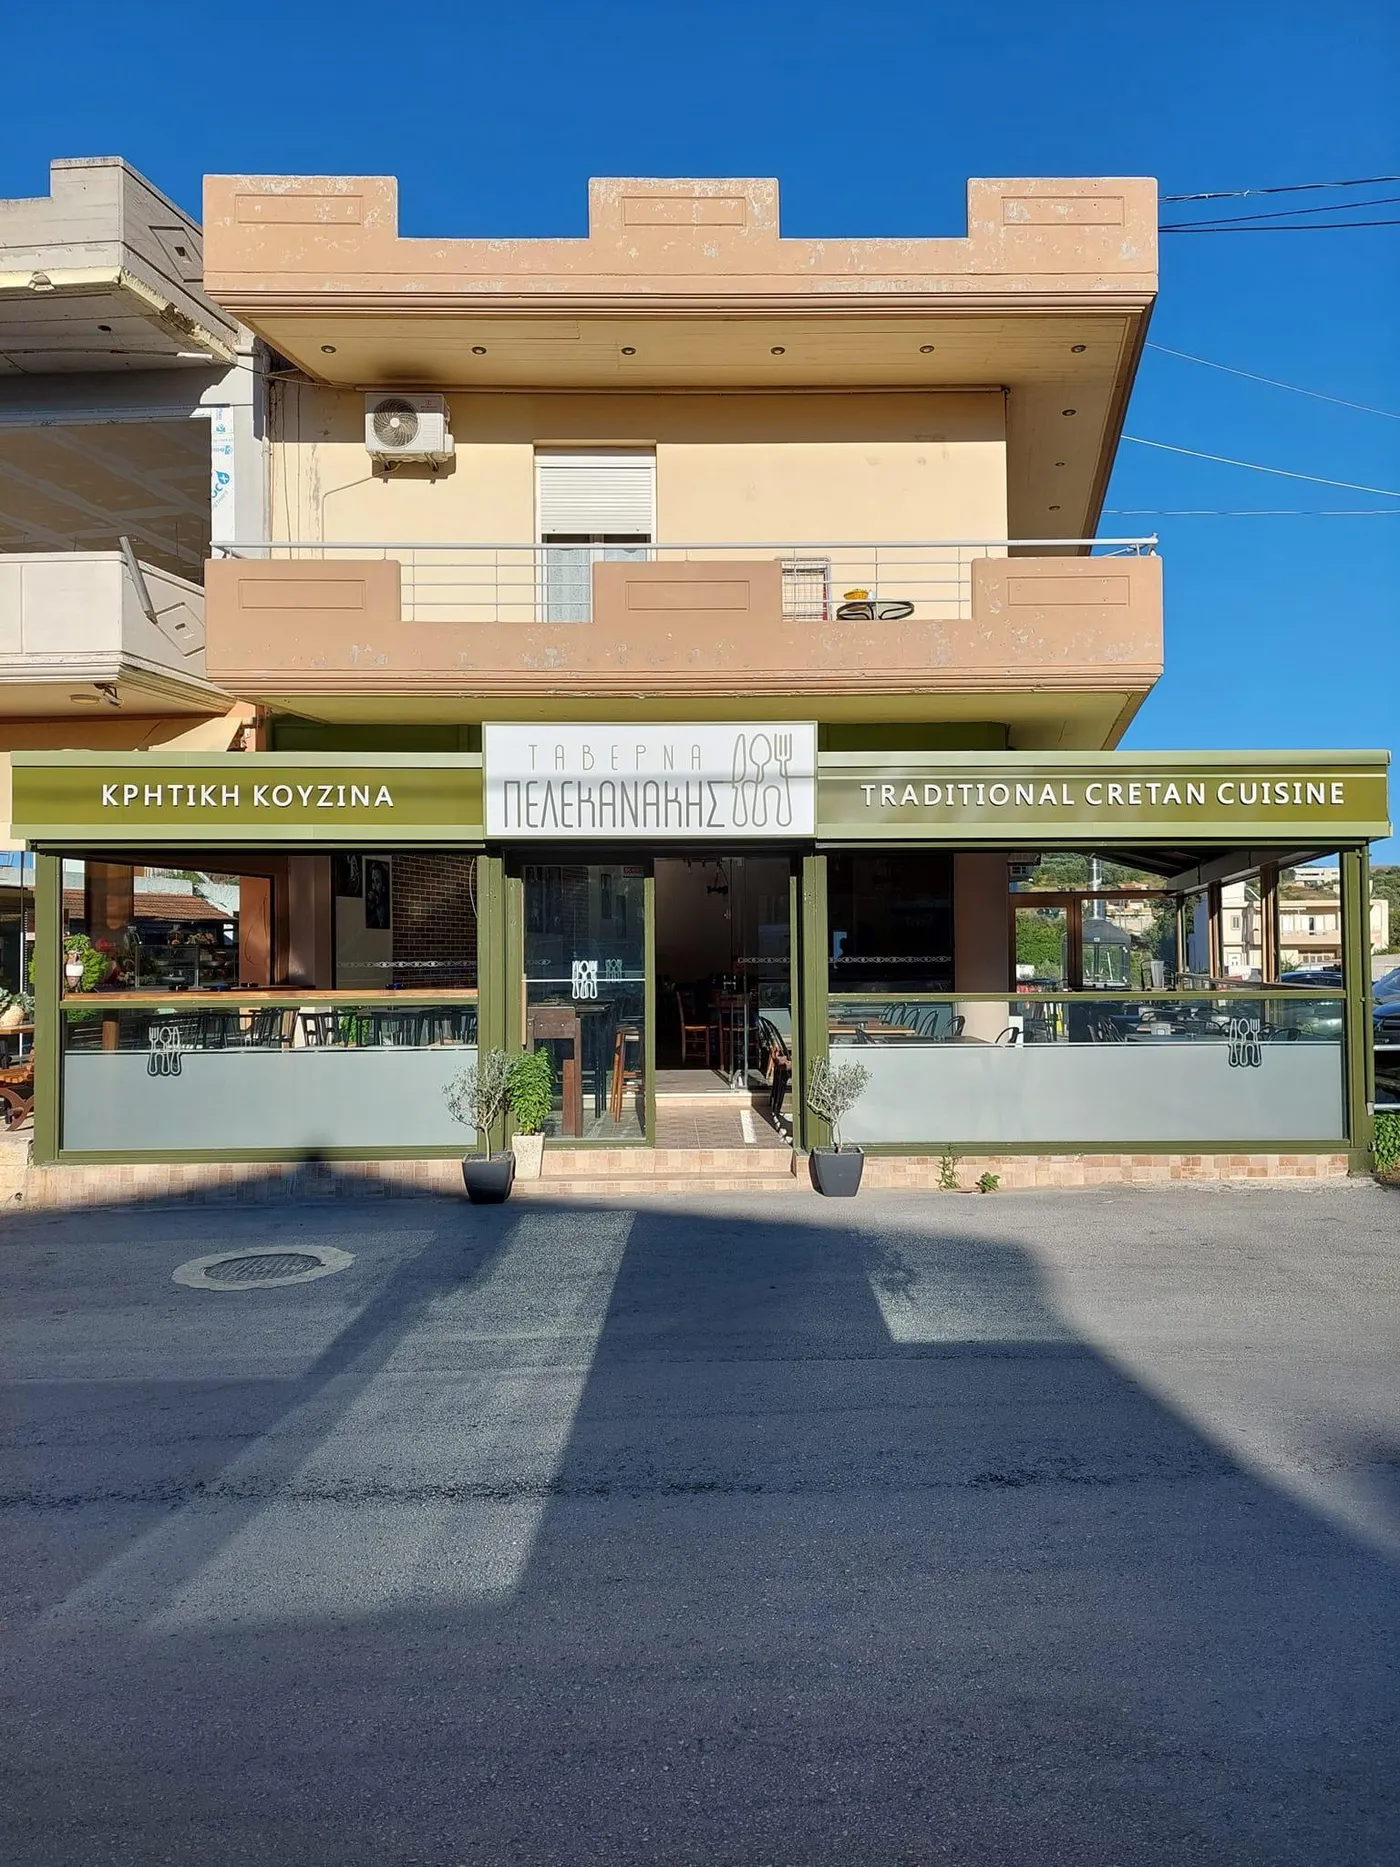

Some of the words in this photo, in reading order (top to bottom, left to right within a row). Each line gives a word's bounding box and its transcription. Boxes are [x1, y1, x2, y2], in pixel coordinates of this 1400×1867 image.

[528, 744, 701, 771] ΤΑΒΕΡΝΑ
[101, 784, 240, 807] ΚΡΗΤΙΚΗ
[253, 784, 395, 808] ΚΟΥΖΙΝΑ
[503, 780, 726, 828] ΠΕΛΕΚΑΝΑΚΗΣ
[860, 783, 1075, 807] TRADITIONAL
[1085, 782, 1206, 806] CRETAN
[1217, 782, 1345, 805] CUISINE
